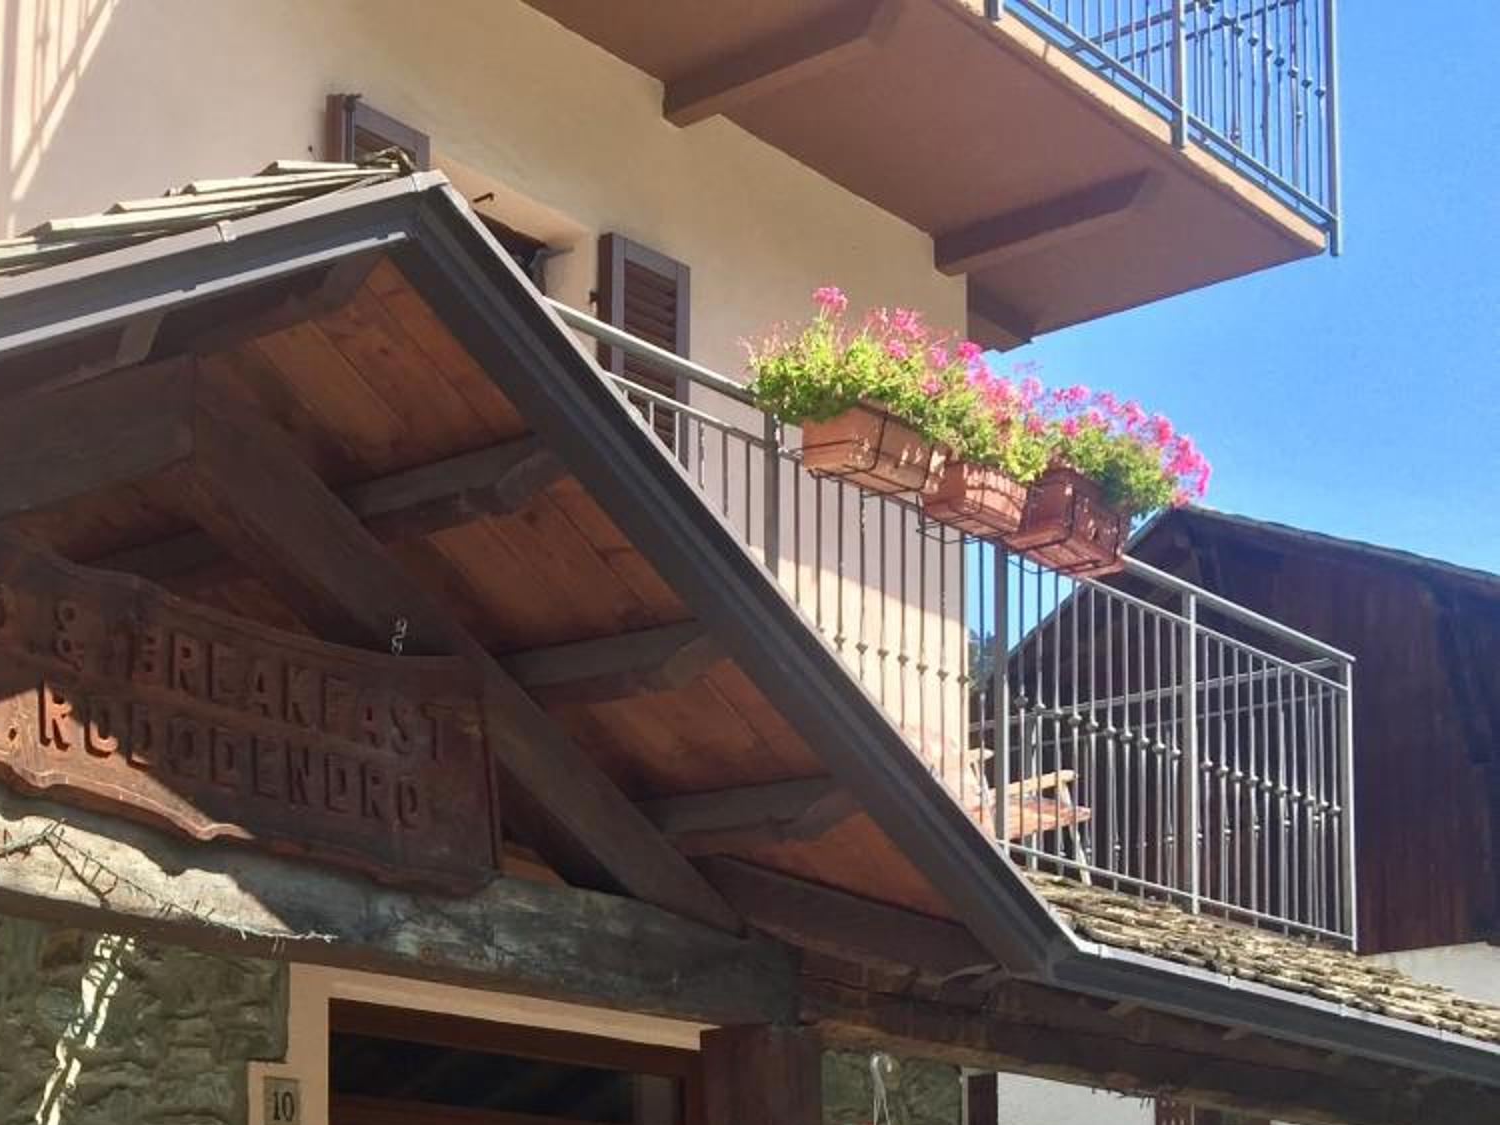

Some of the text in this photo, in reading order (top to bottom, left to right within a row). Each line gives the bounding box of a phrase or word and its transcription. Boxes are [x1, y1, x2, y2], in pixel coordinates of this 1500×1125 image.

[39, 675, 420, 828] RODODENDRO
[54, 601, 84, 670] &
[131, 627, 450, 761] BREAKFAST
[273, 1091, 295, 1122] 10
